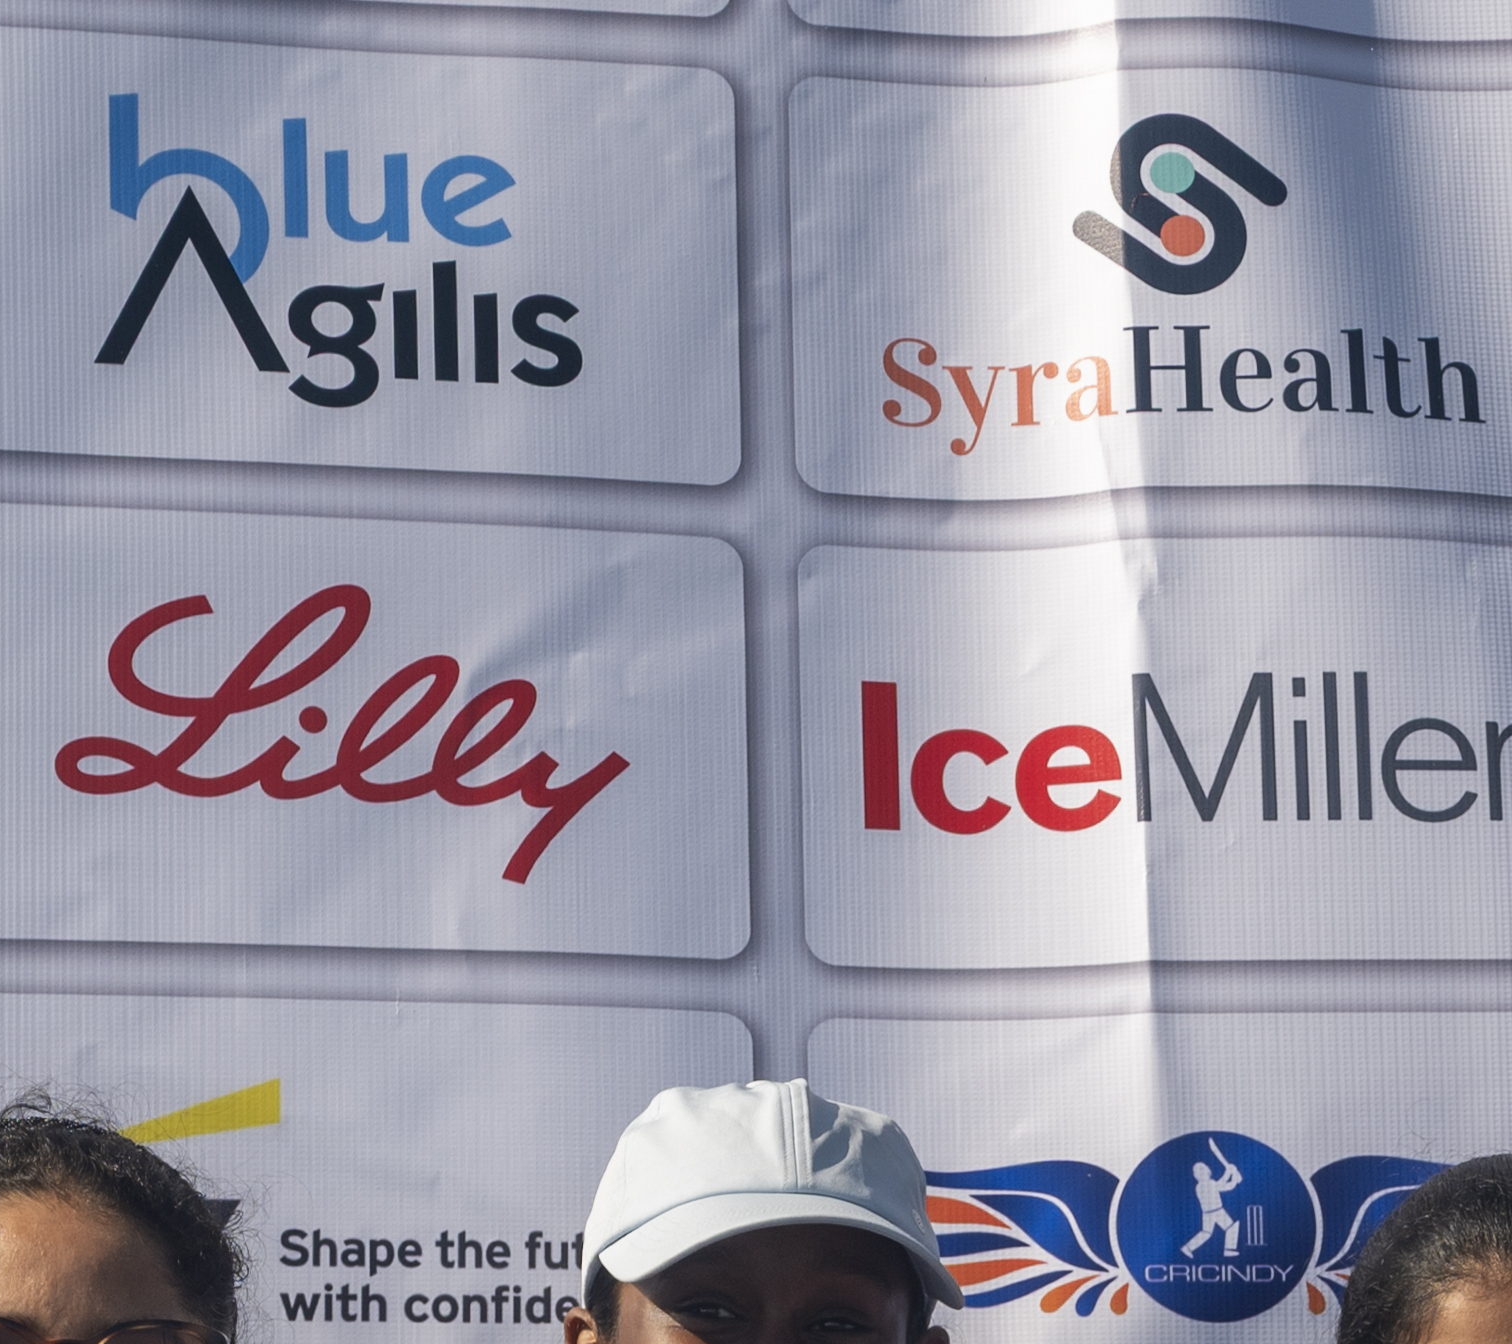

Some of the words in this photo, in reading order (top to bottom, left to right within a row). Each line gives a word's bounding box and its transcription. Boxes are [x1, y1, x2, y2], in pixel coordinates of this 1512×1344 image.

[108, 92, 517, 286] blue
[882, 325, 1487, 457] SyraHealth
[55, 583, 631, 885] Lilly
[279, 1229, 422, 1275] Shape
[436, 1230, 511, 1269] the
[1144, 1263, 1294, 1284] CRICINDY
[280, 1286, 387, 1322] with
